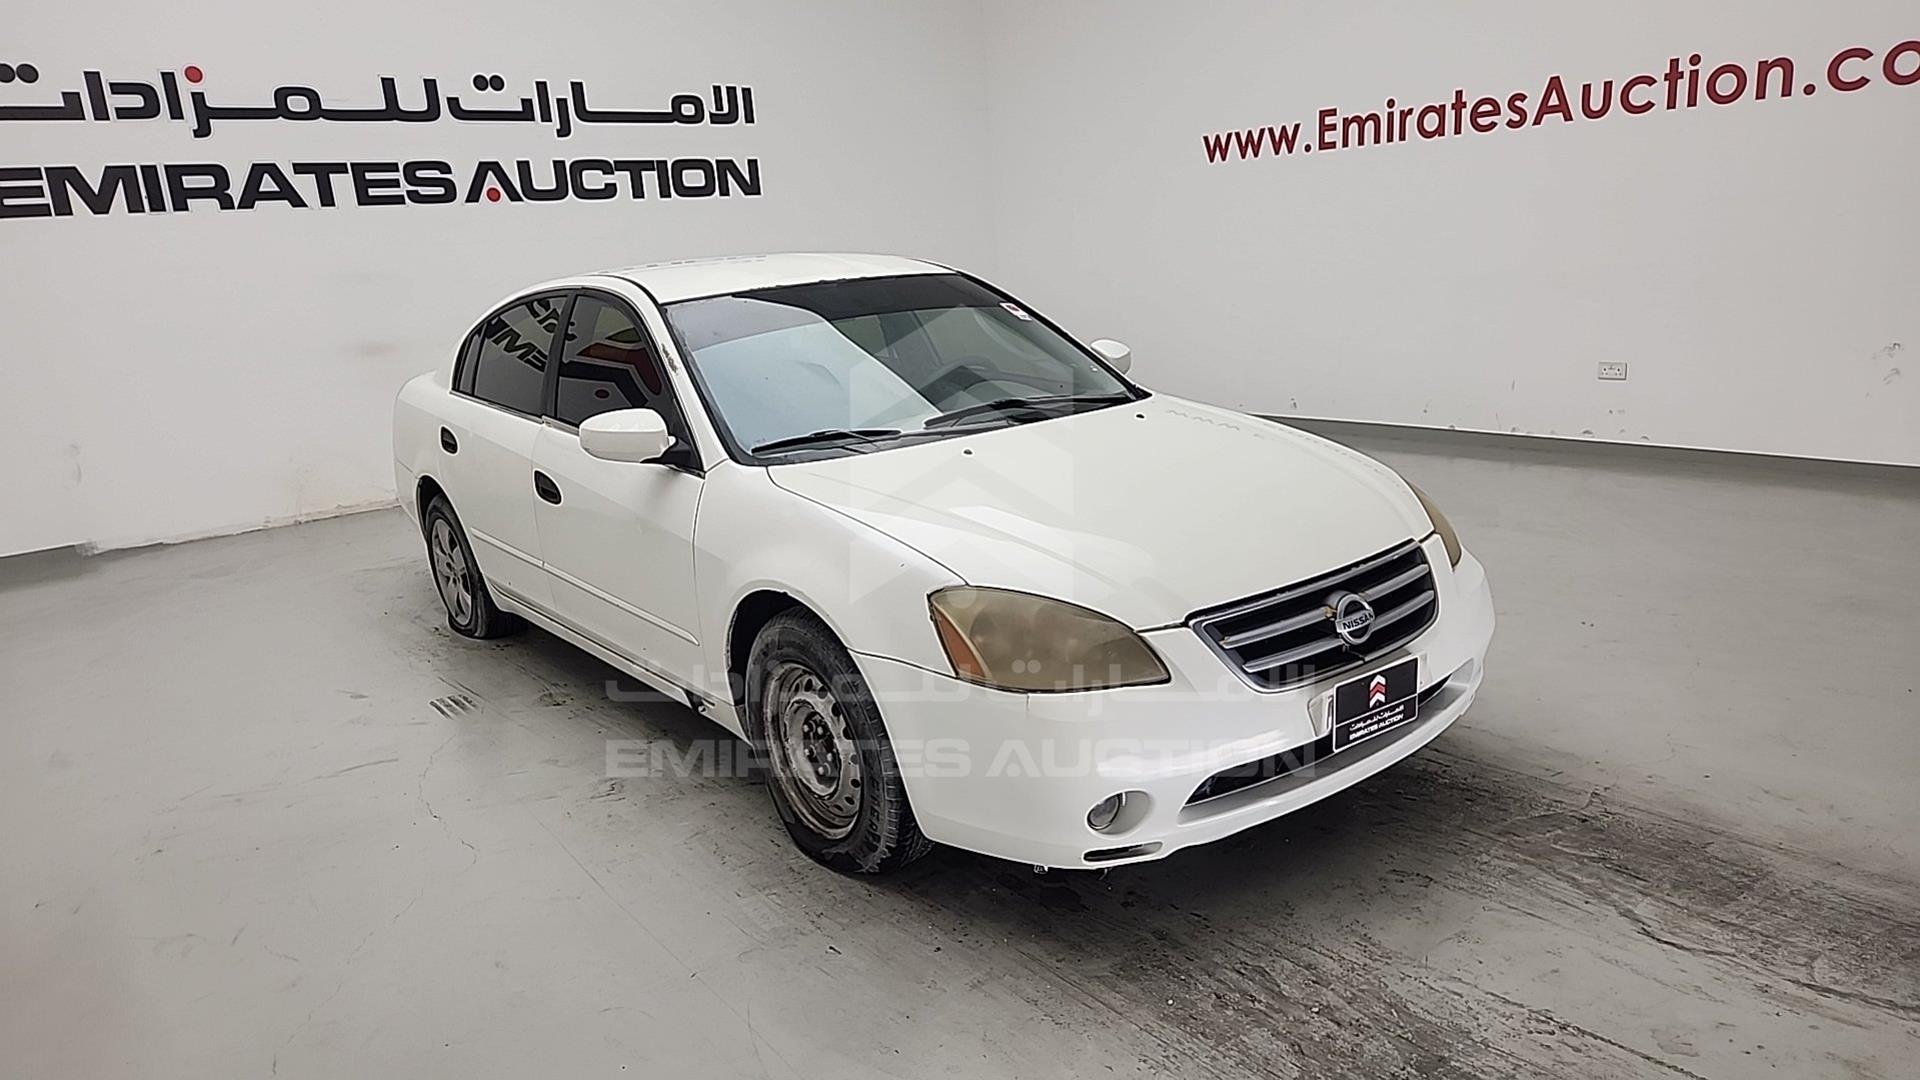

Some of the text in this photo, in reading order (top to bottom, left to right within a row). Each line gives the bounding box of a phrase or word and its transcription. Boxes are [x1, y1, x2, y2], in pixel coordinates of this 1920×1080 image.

[0, 63, 442, 139] للمزادات
[1202, 40, 1920, 164] www.EmiratesAuction.co
[0, 158, 762, 219] EMIRATES AUCTION
[1342, 611, 1374, 630] NISSAN
